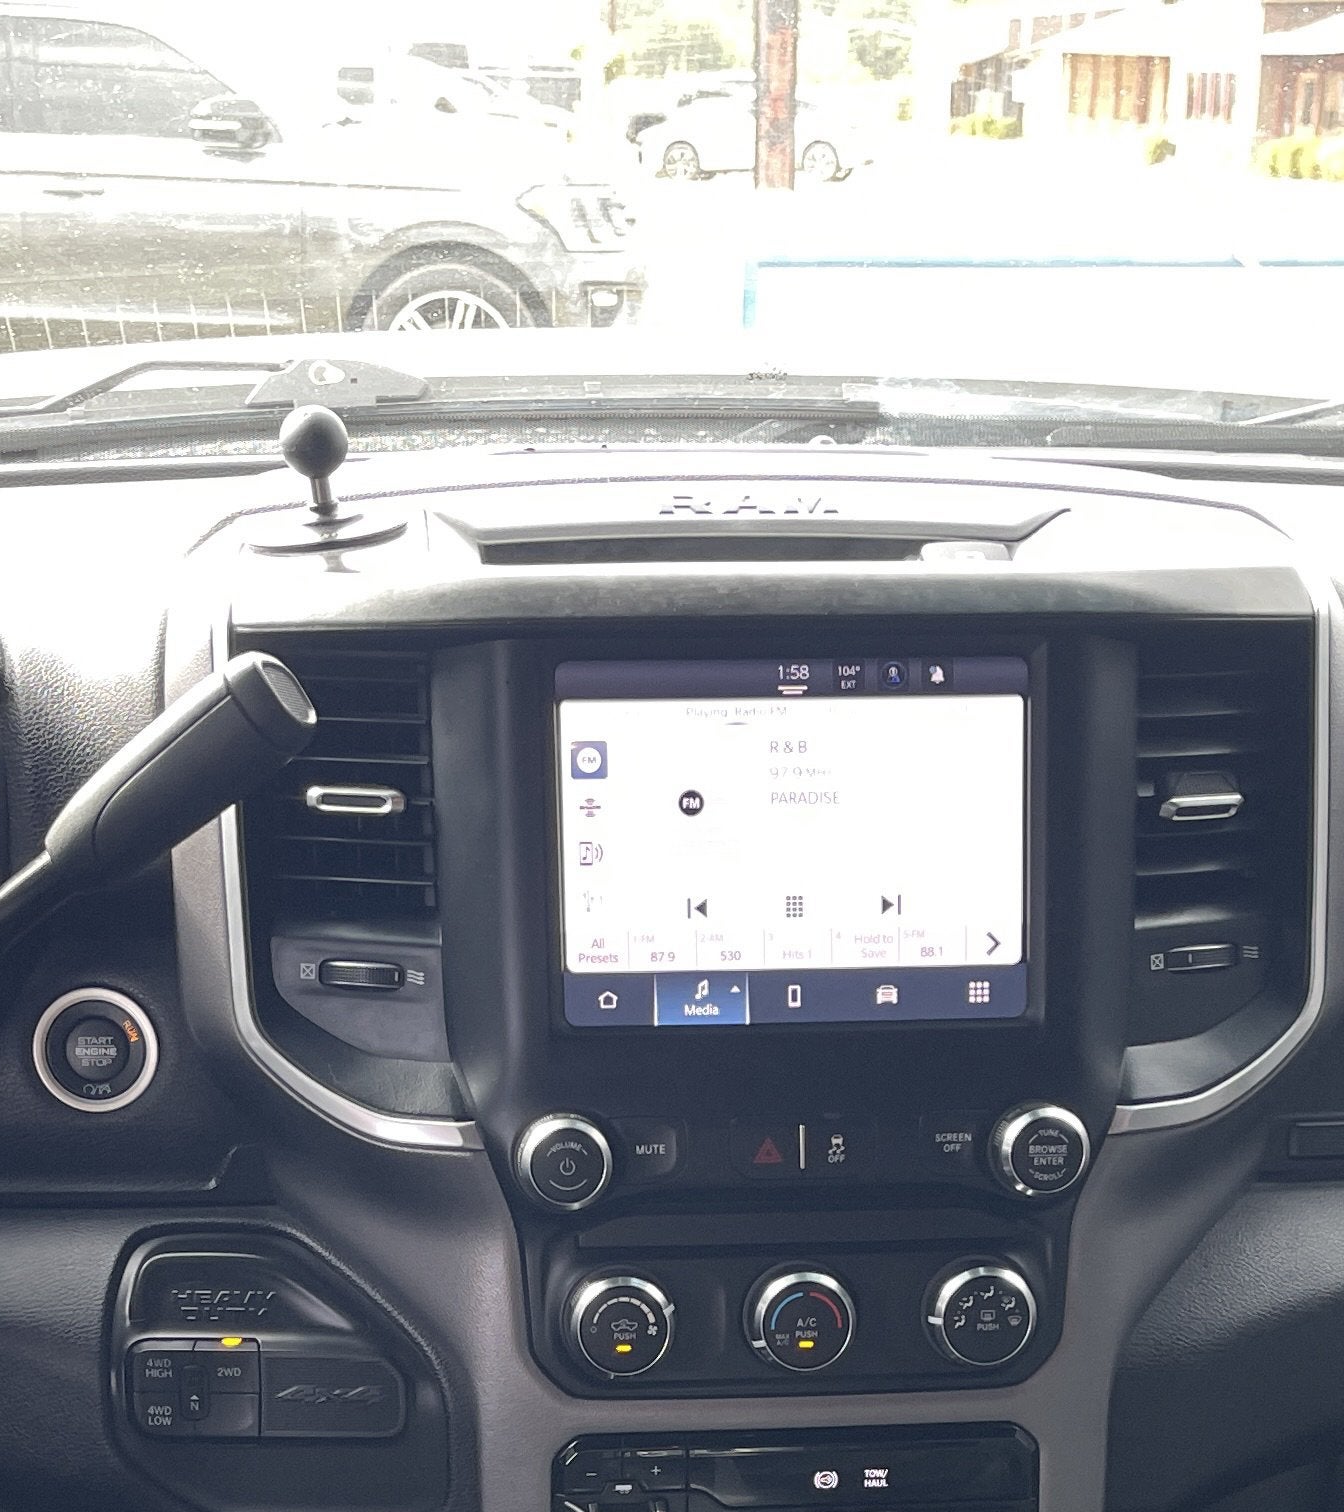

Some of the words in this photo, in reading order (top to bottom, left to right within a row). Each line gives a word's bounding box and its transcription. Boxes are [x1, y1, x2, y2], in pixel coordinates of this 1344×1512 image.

[659, 495, 839, 516] RAM
[778, 664, 810, 680] 1:58
[841, 680, 856, 689] EXT
[770, 766, 803, 779] 979
[771, 791, 840, 804] PARADISE
[682, 796, 701, 810] FM
[591, 938, 605, 949] All
[854, 934, 881, 945] Hold
[578, 952, 619, 964] Presets
[650, 951, 676, 962] 879
[720, 950, 742, 961] 530
[862, 948, 887, 959] Save
[684, 1004, 719, 1016] Media
[122, 1019, 140, 1043] RUN
[77, 1036, 114, 1045] START
[75, 1047, 117, 1056] ENGINE
[81, 1058, 113, 1067] STOP
[935, 1132, 972, 1142] SCREEN
[550, 1141, 583, 1153] VOLUME
[635, 1144, 666, 1155] MUTE
[943, 1144, 961, 1153] OFF
[1029, 1144, 1068, 1153] BROWSE
[827, 1154, 845, 1163] OFF
[1034, 1156, 1064, 1165] ENTER
[1033, 1171, 1064, 1181] SCROLL
[797, 1317, 817, 1328] A/C
[977, 1323, 999, 1331] PUSH
[613, 1332, 636, 1341] PUSH
[795, 1330, 818, 1339] PUSH
[146, 1358, 172, 1368] 4WD
[145, 1368, 172, 1378] HIGH
[217, 1367, 242, 1377] 2WD
[147, 1405, 172, 1416] 4WD
[190, 1401, 199, 1411] N
[148, 1416, 172, 1426] LOW
[864, 1479, 888, 1488] HAUL
